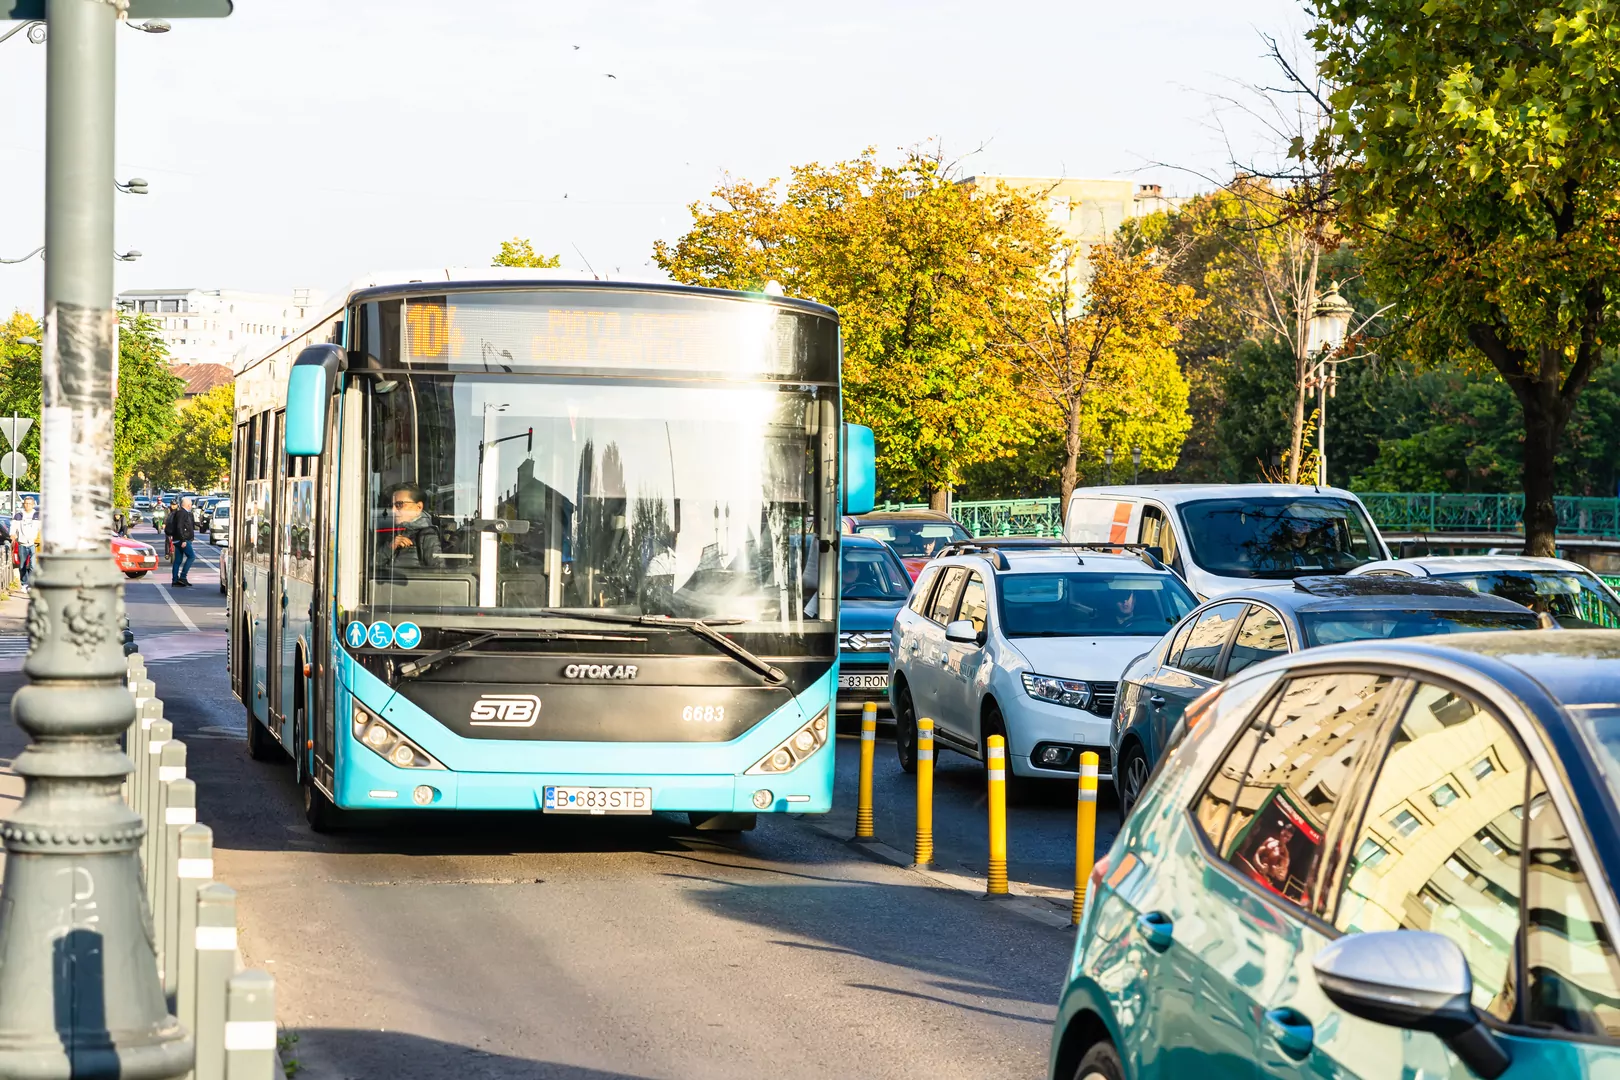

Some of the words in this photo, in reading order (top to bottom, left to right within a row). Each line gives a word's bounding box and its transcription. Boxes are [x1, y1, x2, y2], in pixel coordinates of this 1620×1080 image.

[407, 304, 465, 357] 104
[565, 664, 638, 679] OTOKAR
[848, 675, 861, 687] 83
[864, 675, 888, 687] RON
[470, 699, 535, 721] STB
[682, 705, 725, 722] 6683
